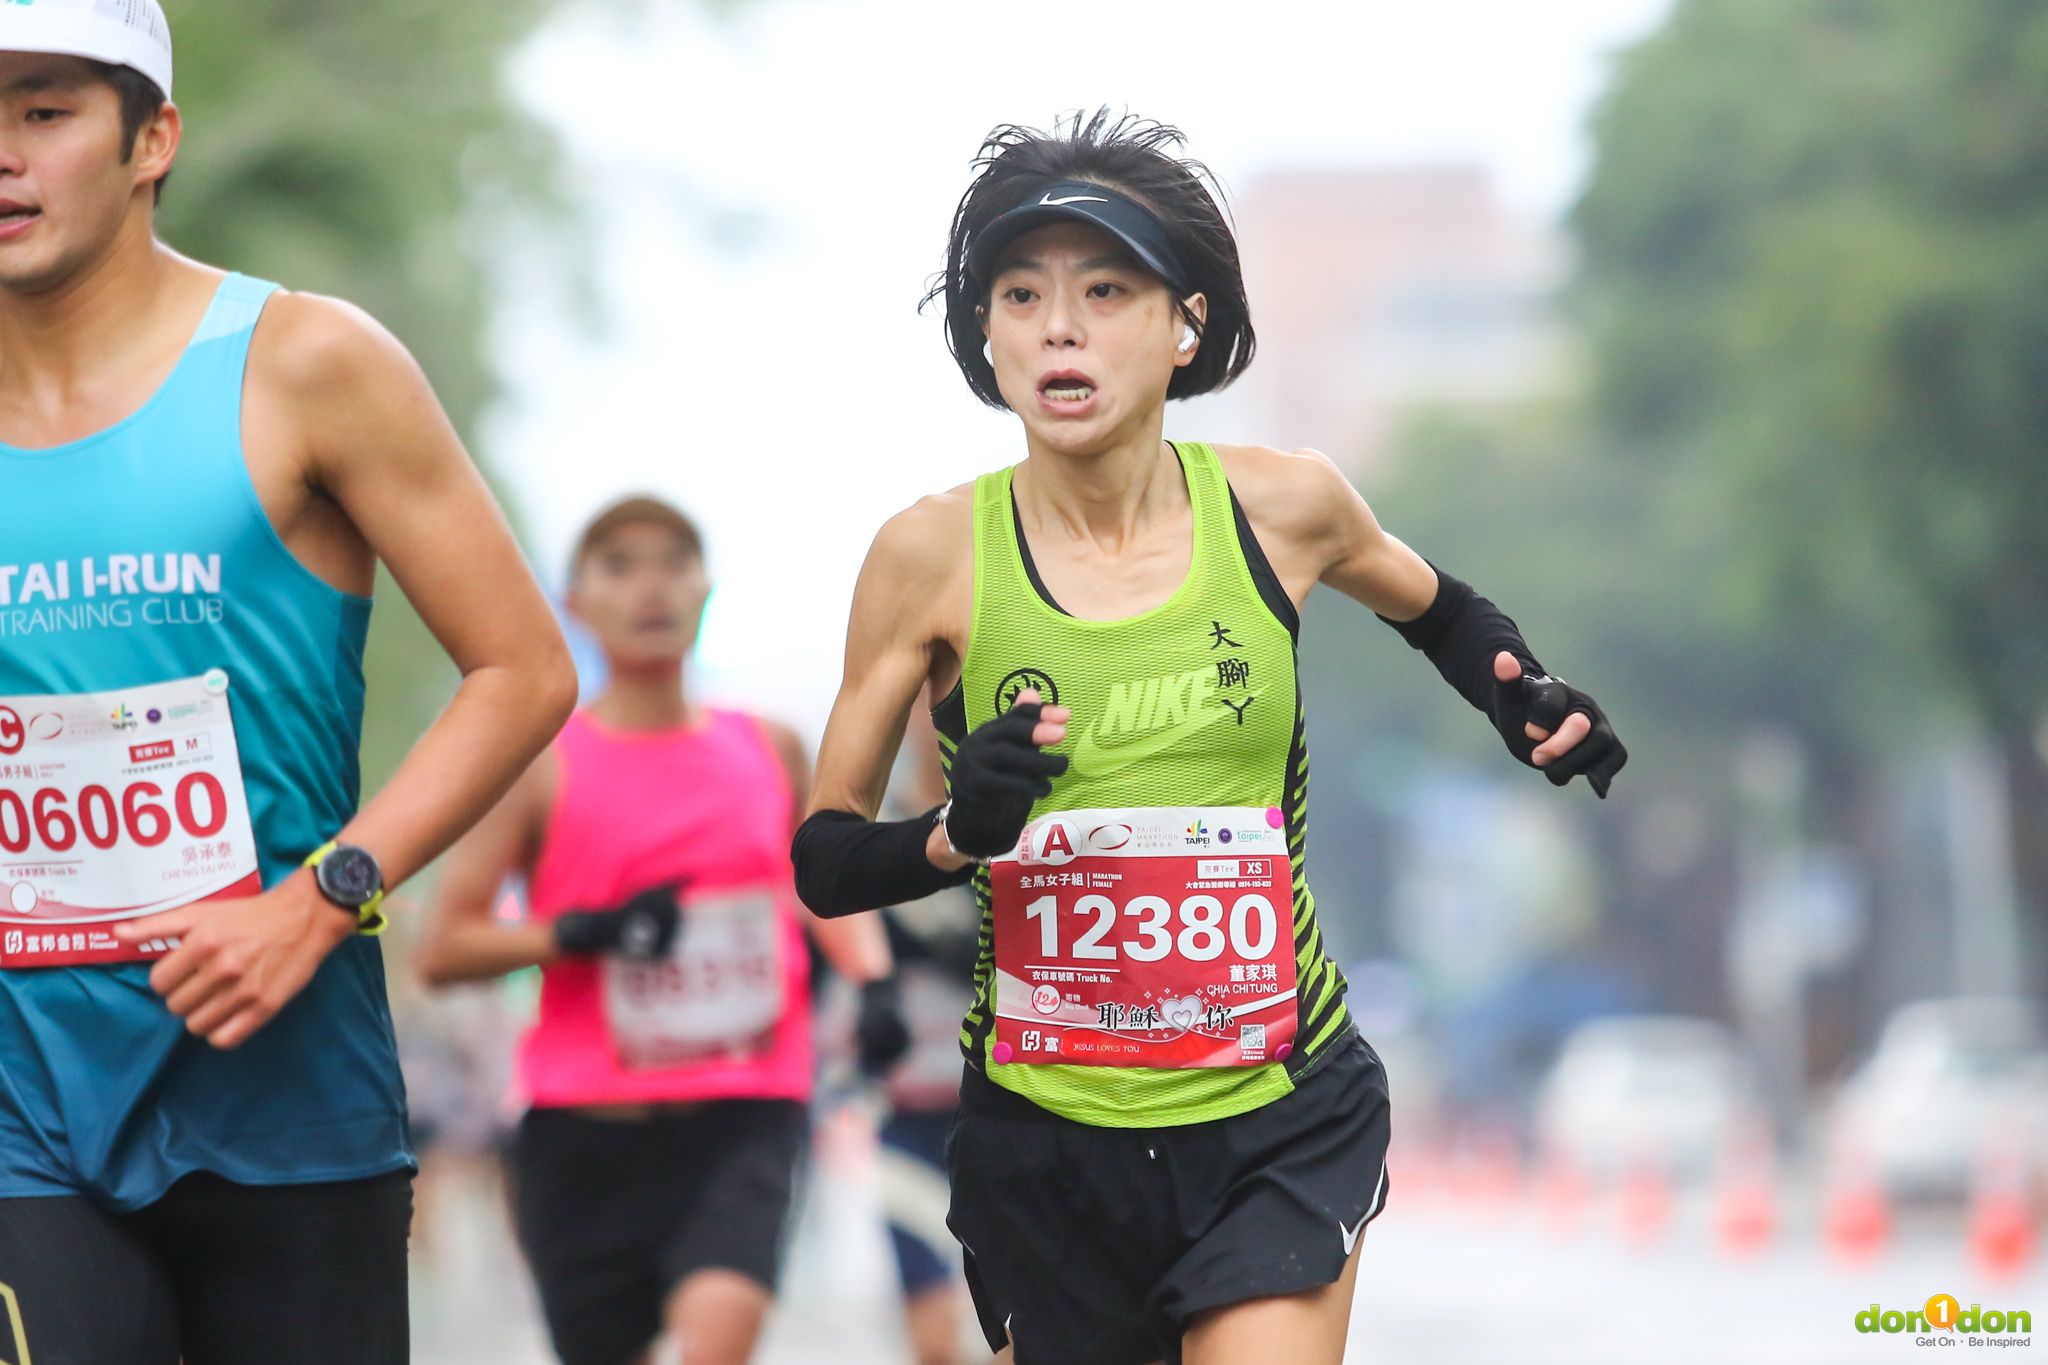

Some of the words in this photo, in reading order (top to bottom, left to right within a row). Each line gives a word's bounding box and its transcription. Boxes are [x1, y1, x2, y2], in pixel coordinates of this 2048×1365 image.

[82, 553, 221, 598] I-RUN
[0, 600, 133, 637] TRAINING
[142, 598, 223, 625] CLUB
[1099, 666, 1219, 738] NIKE
[186, 738, 198, 750] M
[0, 764, 33, 779] 男子組
[0, 771, 228, 854] 06060
[1041, 823, 1075, 858] A
[1185, 837, 1211, 845] TAIPEI
[1237, 830, 1262, 842] taipei
[162, 867, 199, 881] CHENG
[1092, 872, 1123, 881] MARATHON
[1246, 862, 1263, 875] XS
[1020, 872, 1084, 889] 全馬女子組
[1025, 894, 1278, 962] 12380
[1076, 972, 1098, 982] Truck
[1100, 974, 1113, 983] No.
[1229, 963, 1278, 982] 董家琪
[1206, 984, 1231, 994] CHIA
[1095, 1001, 1160, 1031] 耶穌
[1205, 1003, 1235, 1031] 你
[1044, 1036, 1063, 1053] 富
[1073, 1043, 1095, 1052] JESUS
[1096, 1043, 1121, 1052] LOVES
[1123, 1045, 1140, 1053] YOU
